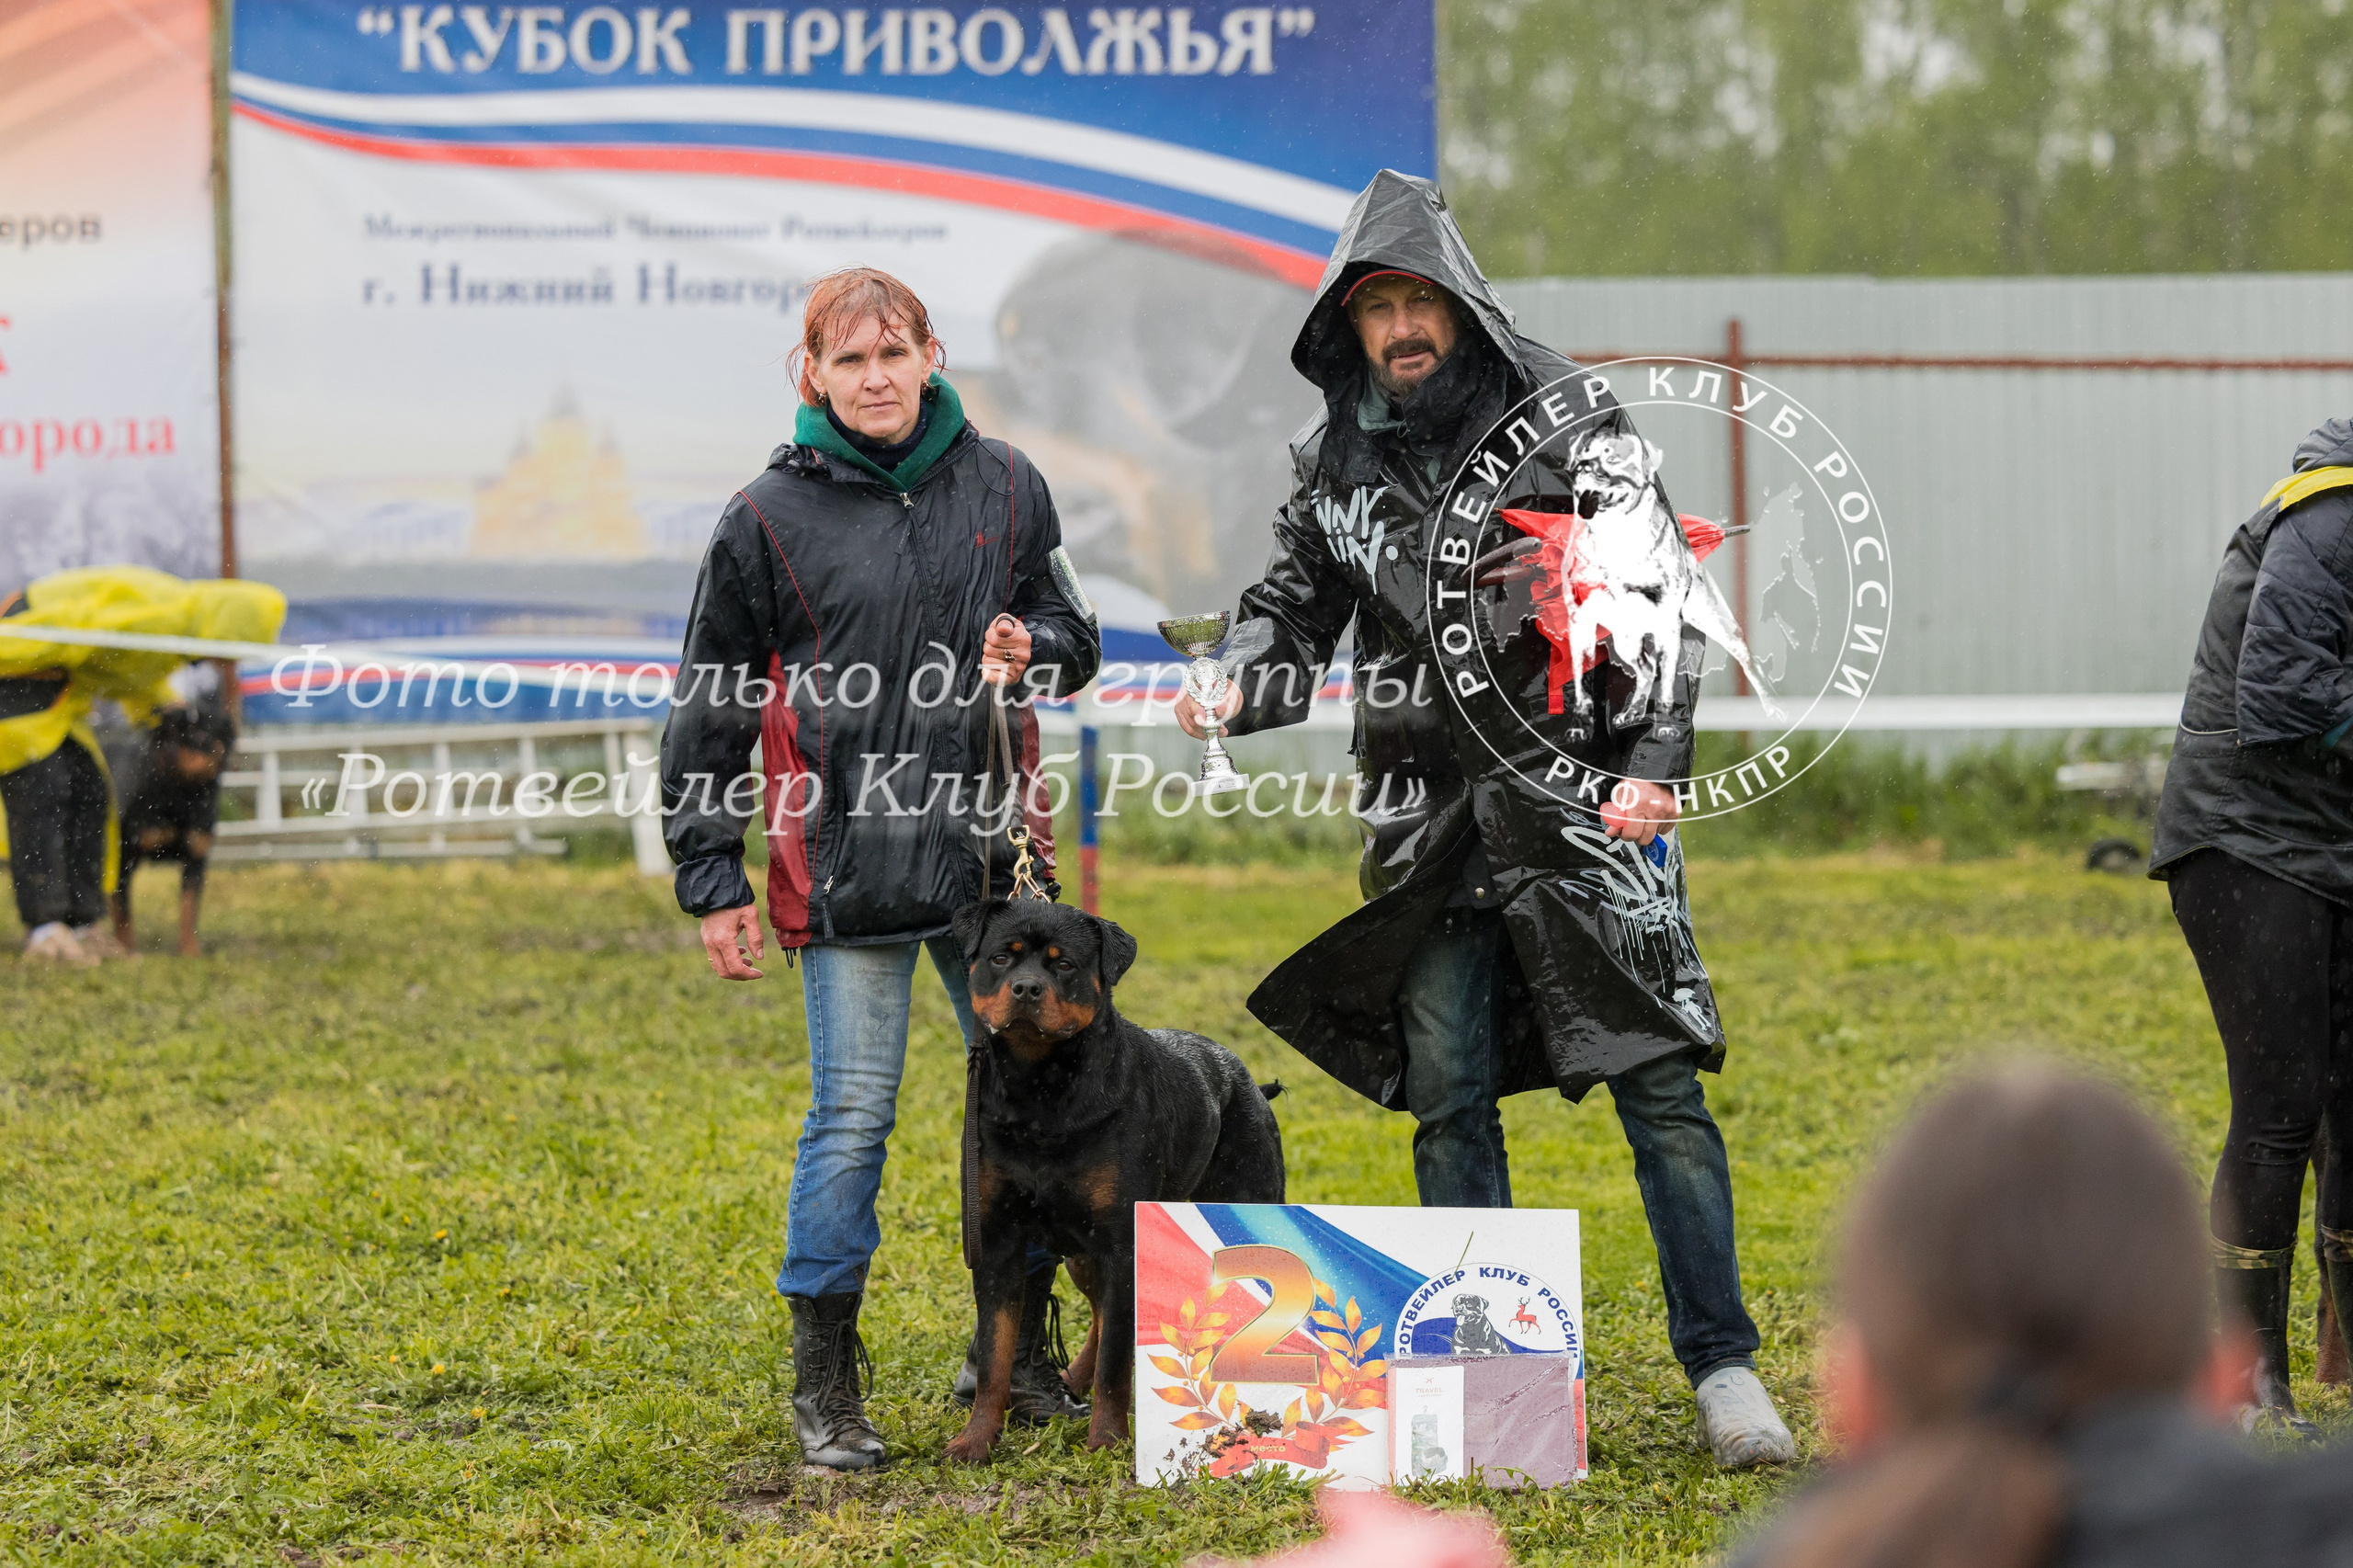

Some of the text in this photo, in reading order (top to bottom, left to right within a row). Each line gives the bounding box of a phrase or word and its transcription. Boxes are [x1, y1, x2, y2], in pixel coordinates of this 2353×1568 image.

[420, 262, 616, 306] Нижний
[637, 262, 809, 314] Новгор
[1209, 1244, 1319, 1384] 2
[1399, 1269, 1466, 1357] РОТВЕЙЛЕР
[1479, 1267, 1530, 1287] КЛУБ
[1250, 1445, 1286, 1453] место
